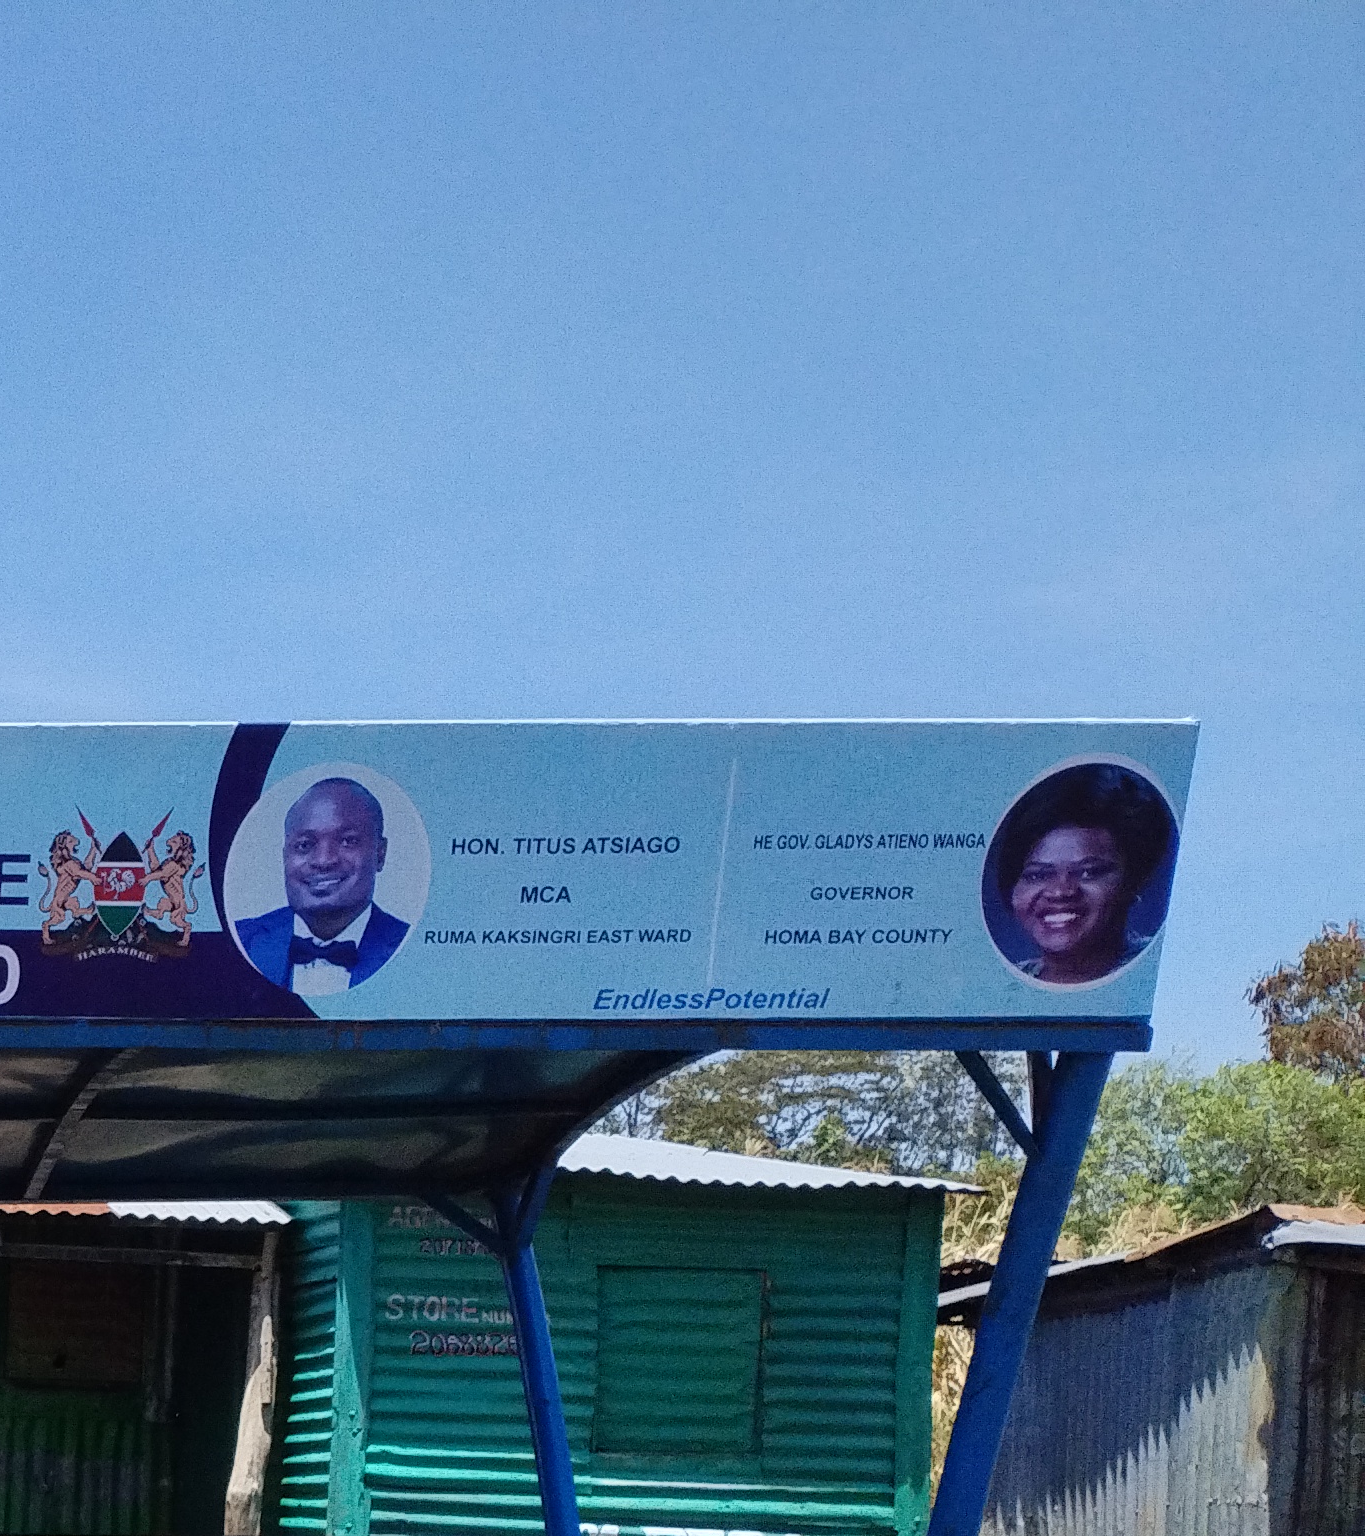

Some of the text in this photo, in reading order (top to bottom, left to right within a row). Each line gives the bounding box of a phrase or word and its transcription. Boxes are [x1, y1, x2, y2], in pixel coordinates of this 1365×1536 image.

[450, 835, 681, 856] HON. TITUS ATSIAGO
[753, 832, 987, 850] HE GOV. GLADYS ATIENO WANGA
[519, 885, 572, 904] MCA
[810, 886, 915, 901] GOVERNOR
[424, 928, 692, 944] RUMA KAKSINGRI EAST WARD
[764, 928, 953, 945] HOMA BAY COUNTY
[592, 987, 832, 1010] EndlessPotential
[384, 1293, 480, 1325] STORE
